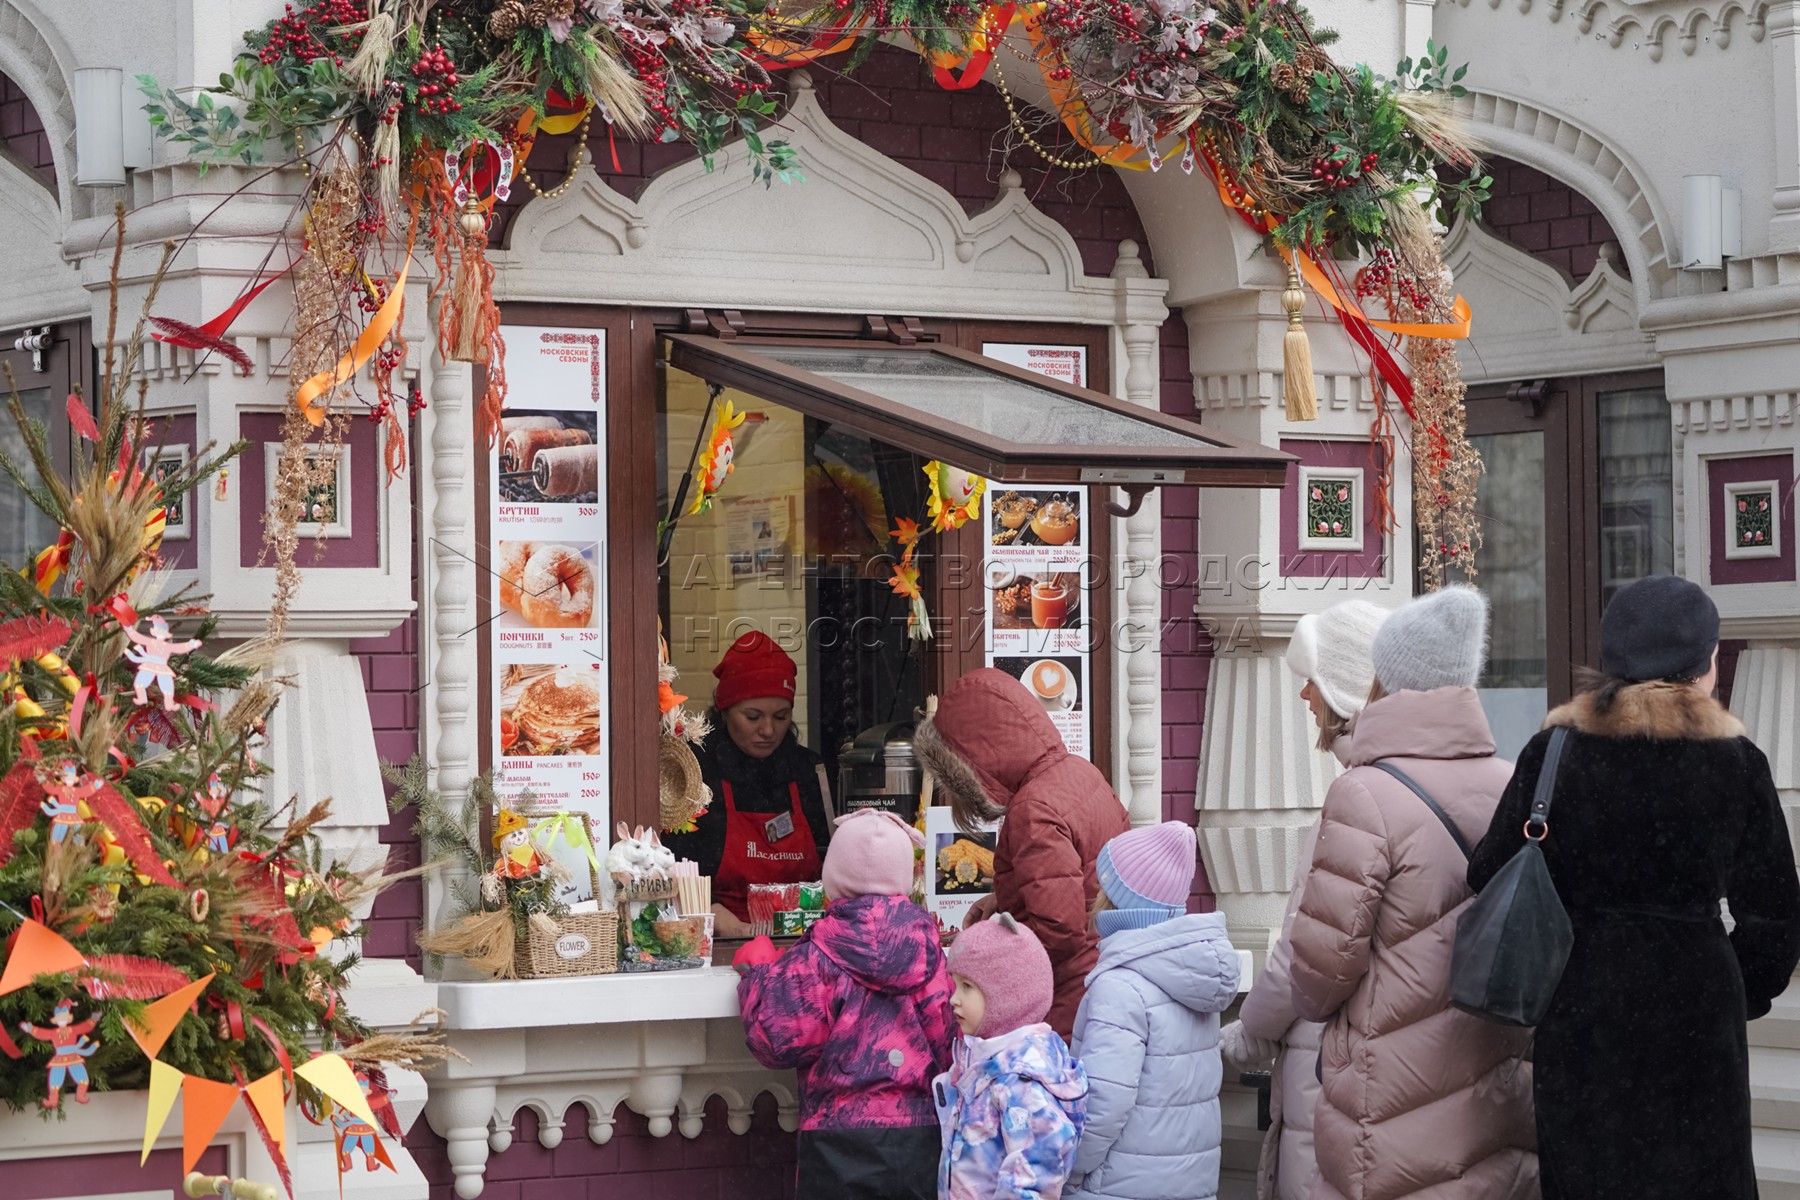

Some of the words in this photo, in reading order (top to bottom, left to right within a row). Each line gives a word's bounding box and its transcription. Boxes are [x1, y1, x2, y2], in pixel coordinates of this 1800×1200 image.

[540, 348, 589, 356] МОСКОВСКИЕ
[1027, 362, 1071, 370] МОСКОВСКИЕ
[499, 506, 540, 518] КРУТИШ
[500, 633, 544, 641] ПОНЧИКИ
[501, 761, 533, 769] БЛИНЫ
[559, 940, 586, 952] FLOWER
